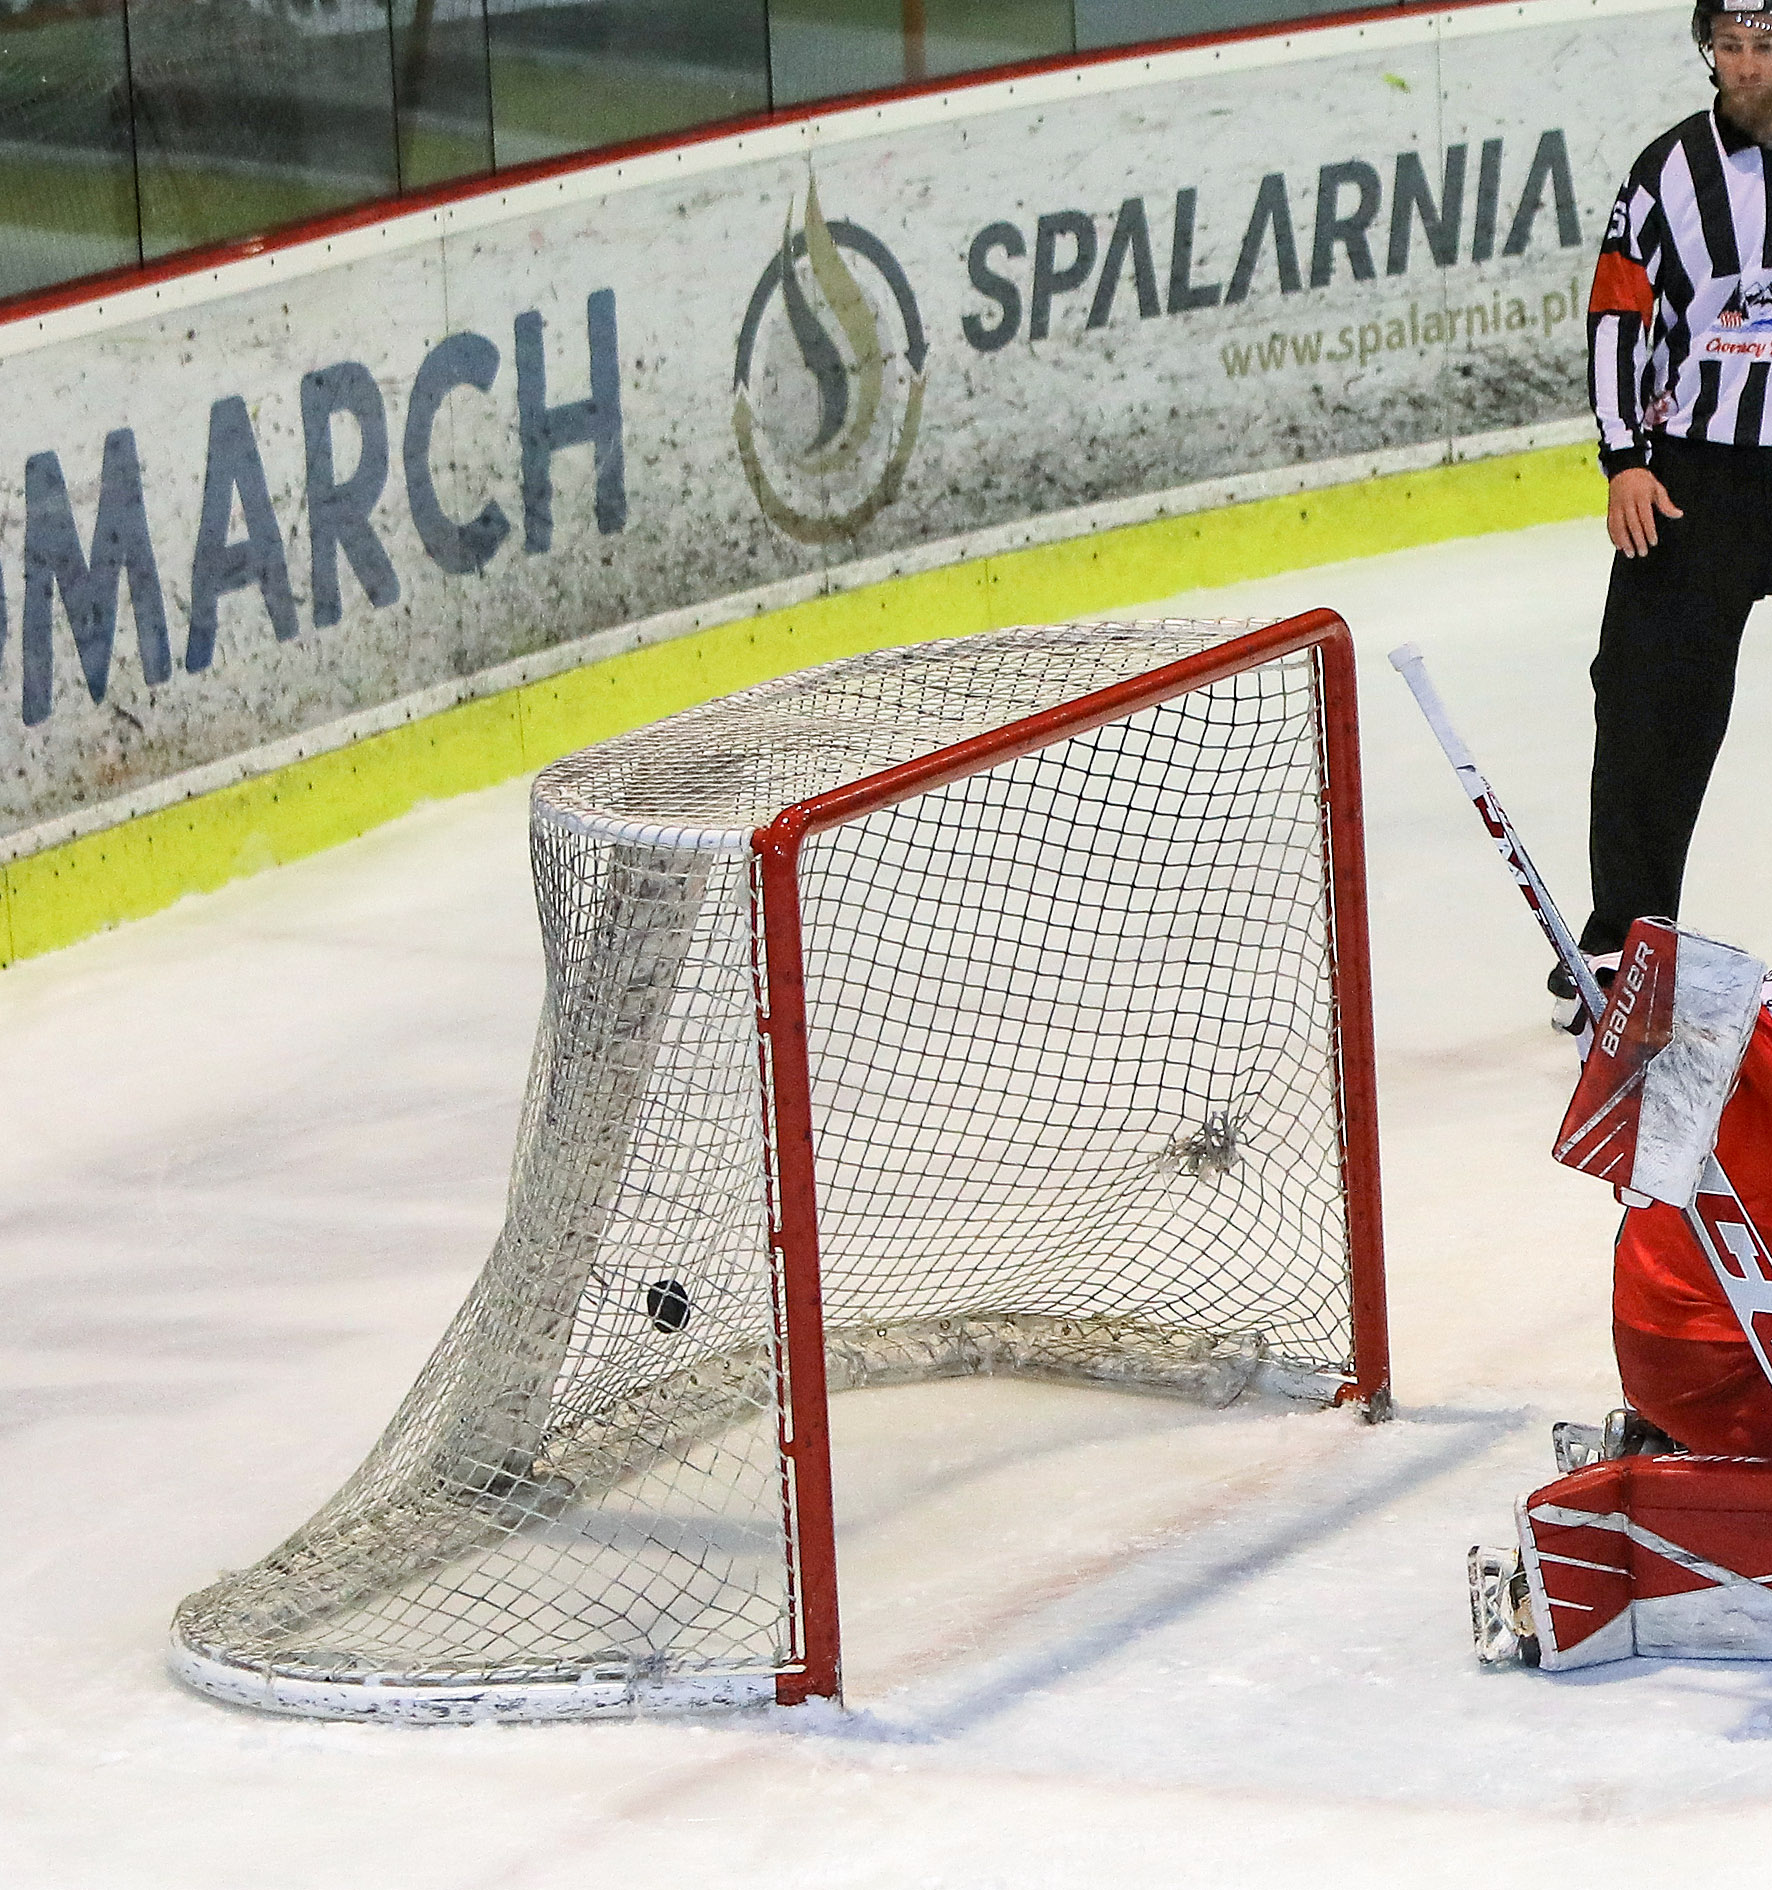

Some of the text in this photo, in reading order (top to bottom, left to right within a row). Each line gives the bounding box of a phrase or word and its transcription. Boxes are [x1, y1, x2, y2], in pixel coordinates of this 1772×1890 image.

[960, 127, 1584, 354] SPALARNIA
[1218, 276, 1583, 382] www.spalarnia.pl
[0, 286, 627, 728] MARCH
[1601, 940, 1655, 1059] BAUER
